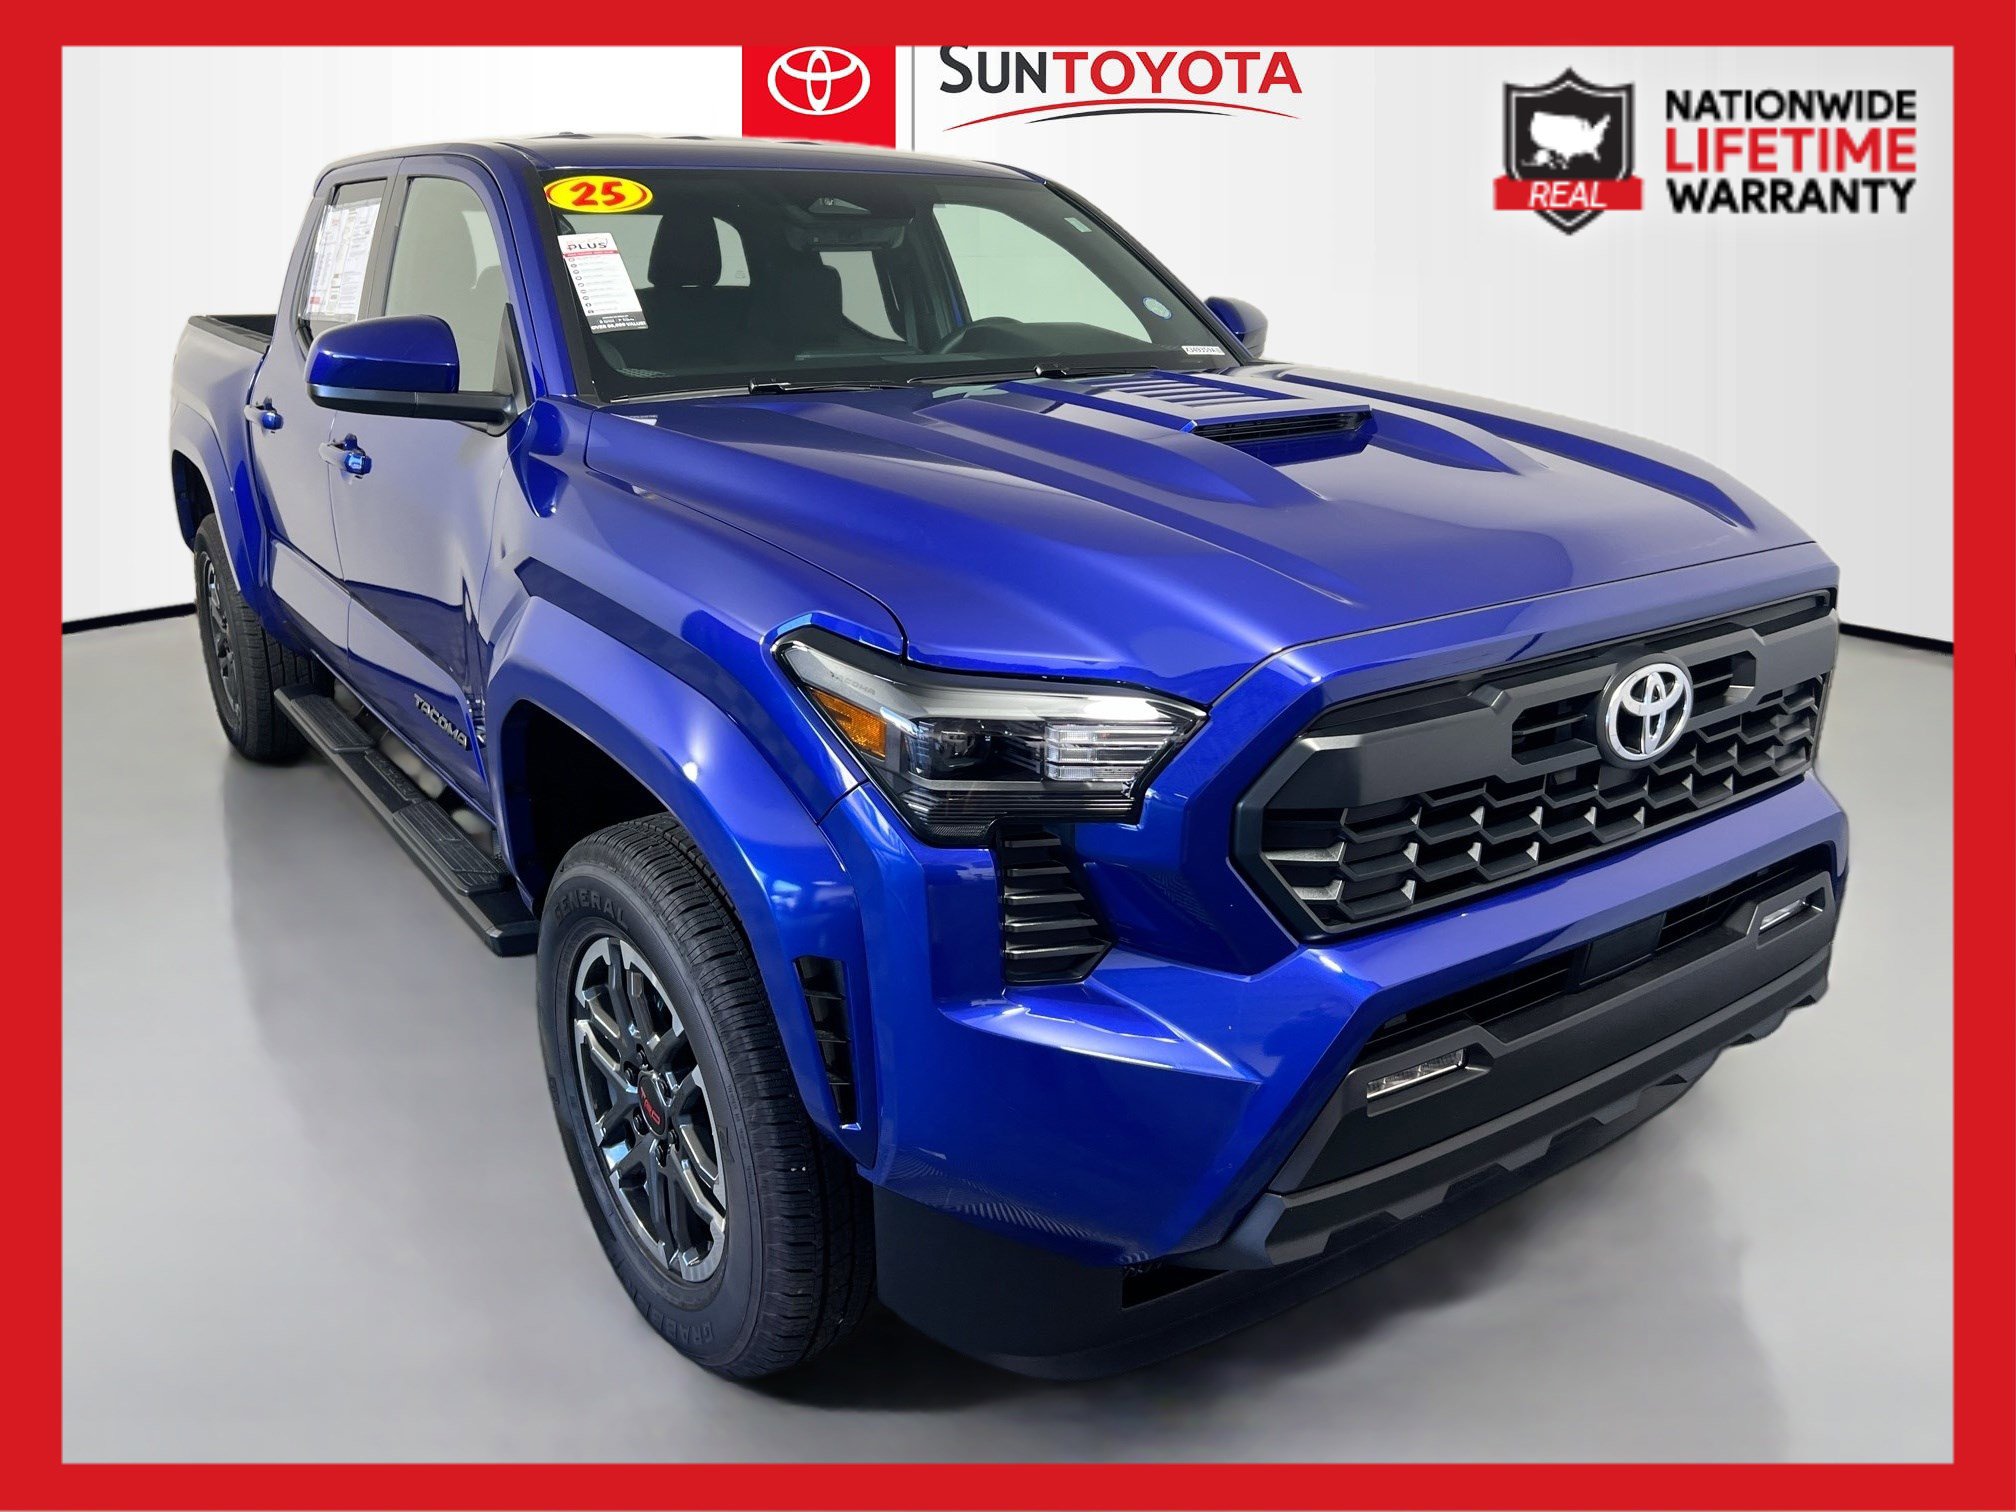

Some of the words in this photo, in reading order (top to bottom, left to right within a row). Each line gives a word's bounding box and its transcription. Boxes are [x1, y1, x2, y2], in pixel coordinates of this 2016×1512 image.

[570, 181, 626, 207] 25
[567, 241, 608, 251] PLUS
[413, 692, 468, 748] TACOMA
[555, 887, 631, 928] GENERAL
[639, 1086, 661, 1126] TRD
